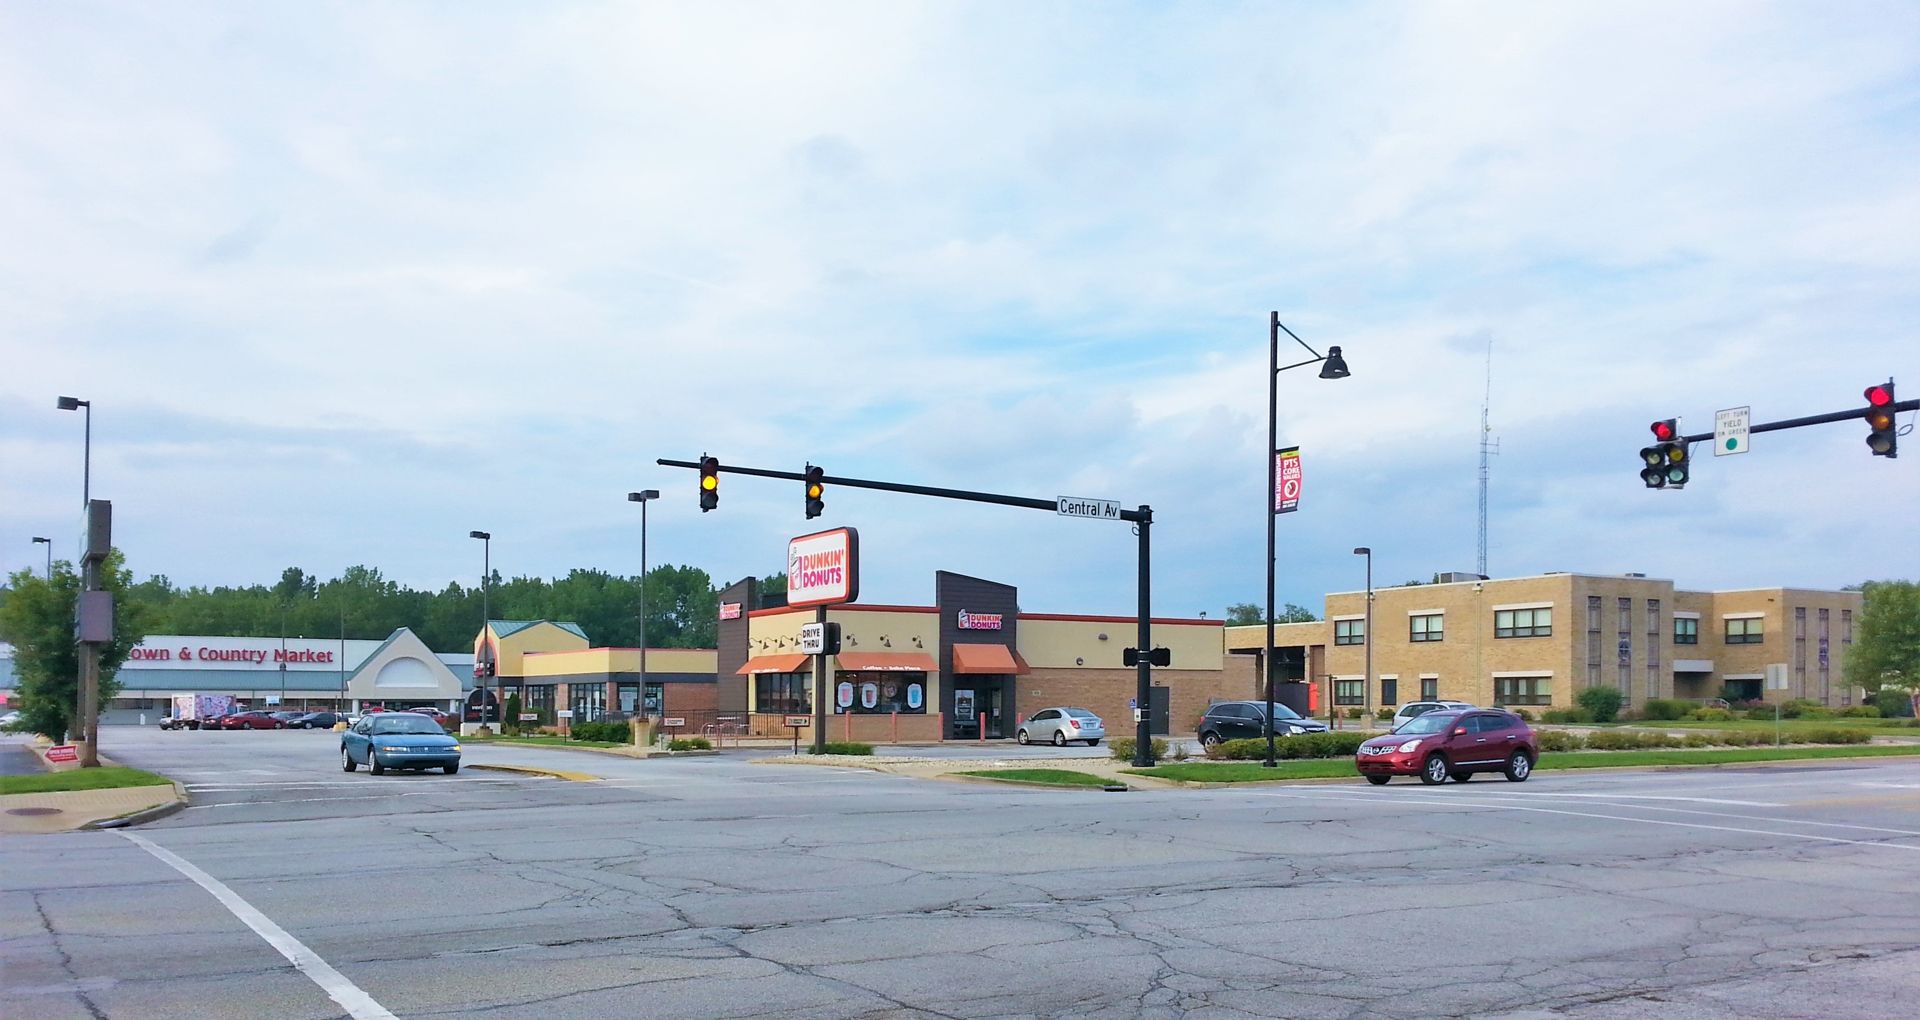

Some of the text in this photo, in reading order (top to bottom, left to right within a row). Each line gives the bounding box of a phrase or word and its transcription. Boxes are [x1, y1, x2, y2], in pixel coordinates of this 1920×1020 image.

[1724, 419, 1741, 427] YIELD
[1283, 458, 1298, 468] PTS
[1060, 498, 1117, 517] Central Av
[803, 549, 844, 571] DUNKIN'
[803, 567, 842, 588] DONUTS
[970, 621, 1001, 629] DONUTS
[802, 628, 821, 638] DRIVE
[803, 639, 820, 649] THRU
[131, 646, 334, 665] own & Country Market
